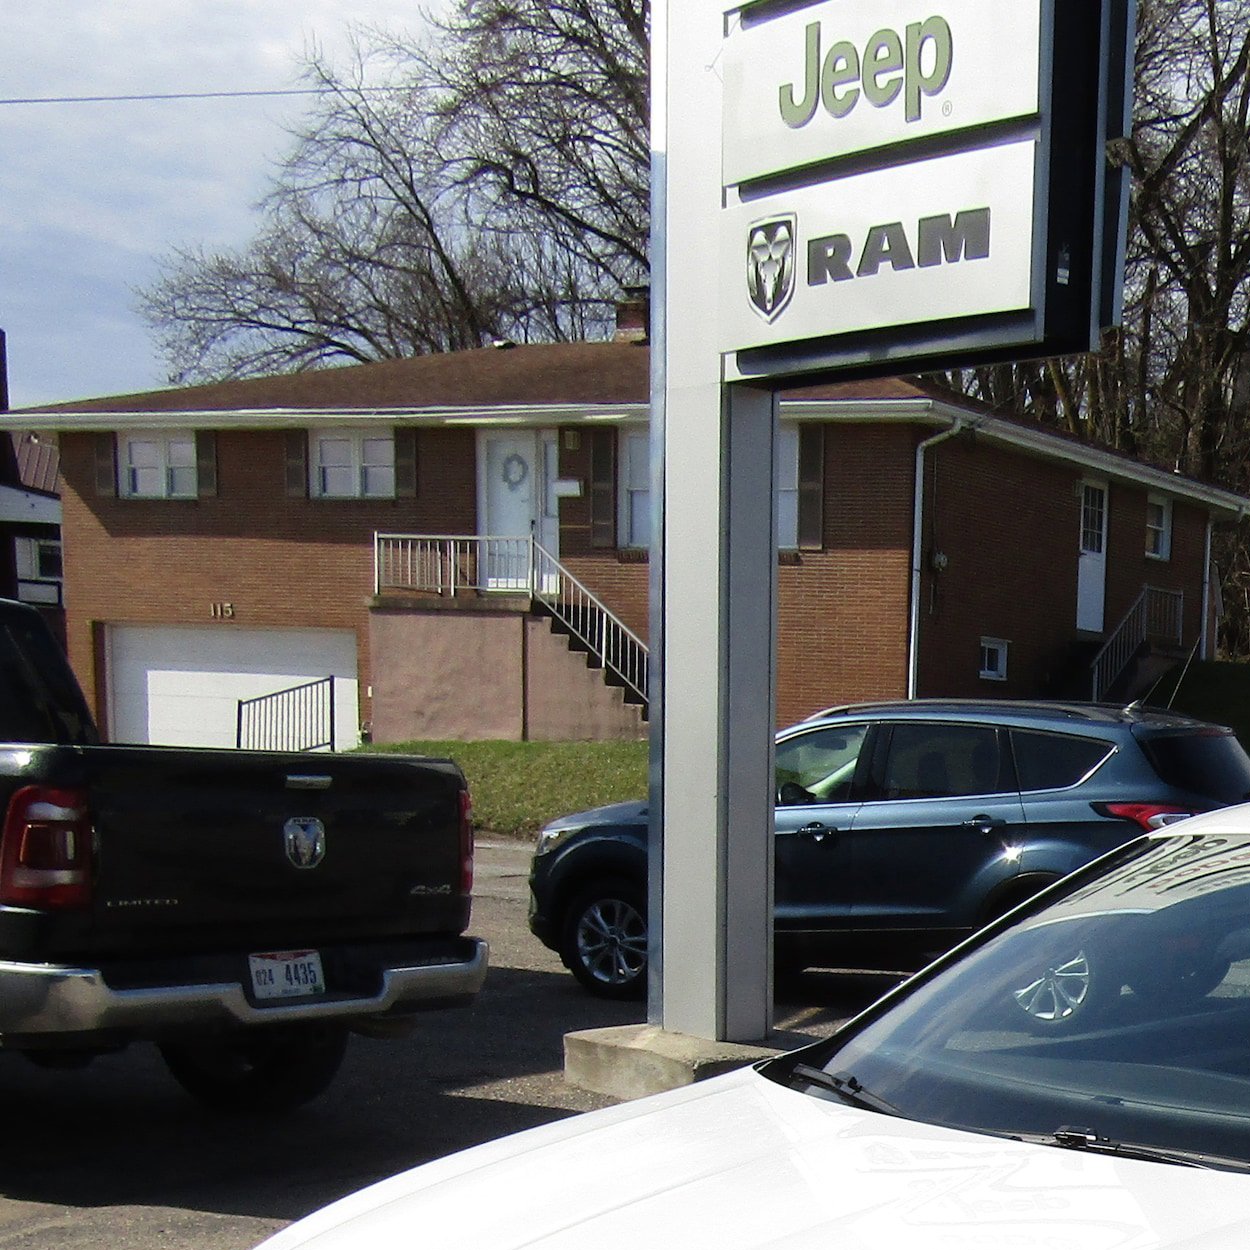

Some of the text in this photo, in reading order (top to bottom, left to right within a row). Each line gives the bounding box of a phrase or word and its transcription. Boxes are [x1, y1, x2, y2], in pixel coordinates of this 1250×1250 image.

[779, 15, 952, 129] Jeep
[807, 207, 990, 287] RAM
[210, 603, 233, 618] 115
[285, 962, 317, 986] 4435
